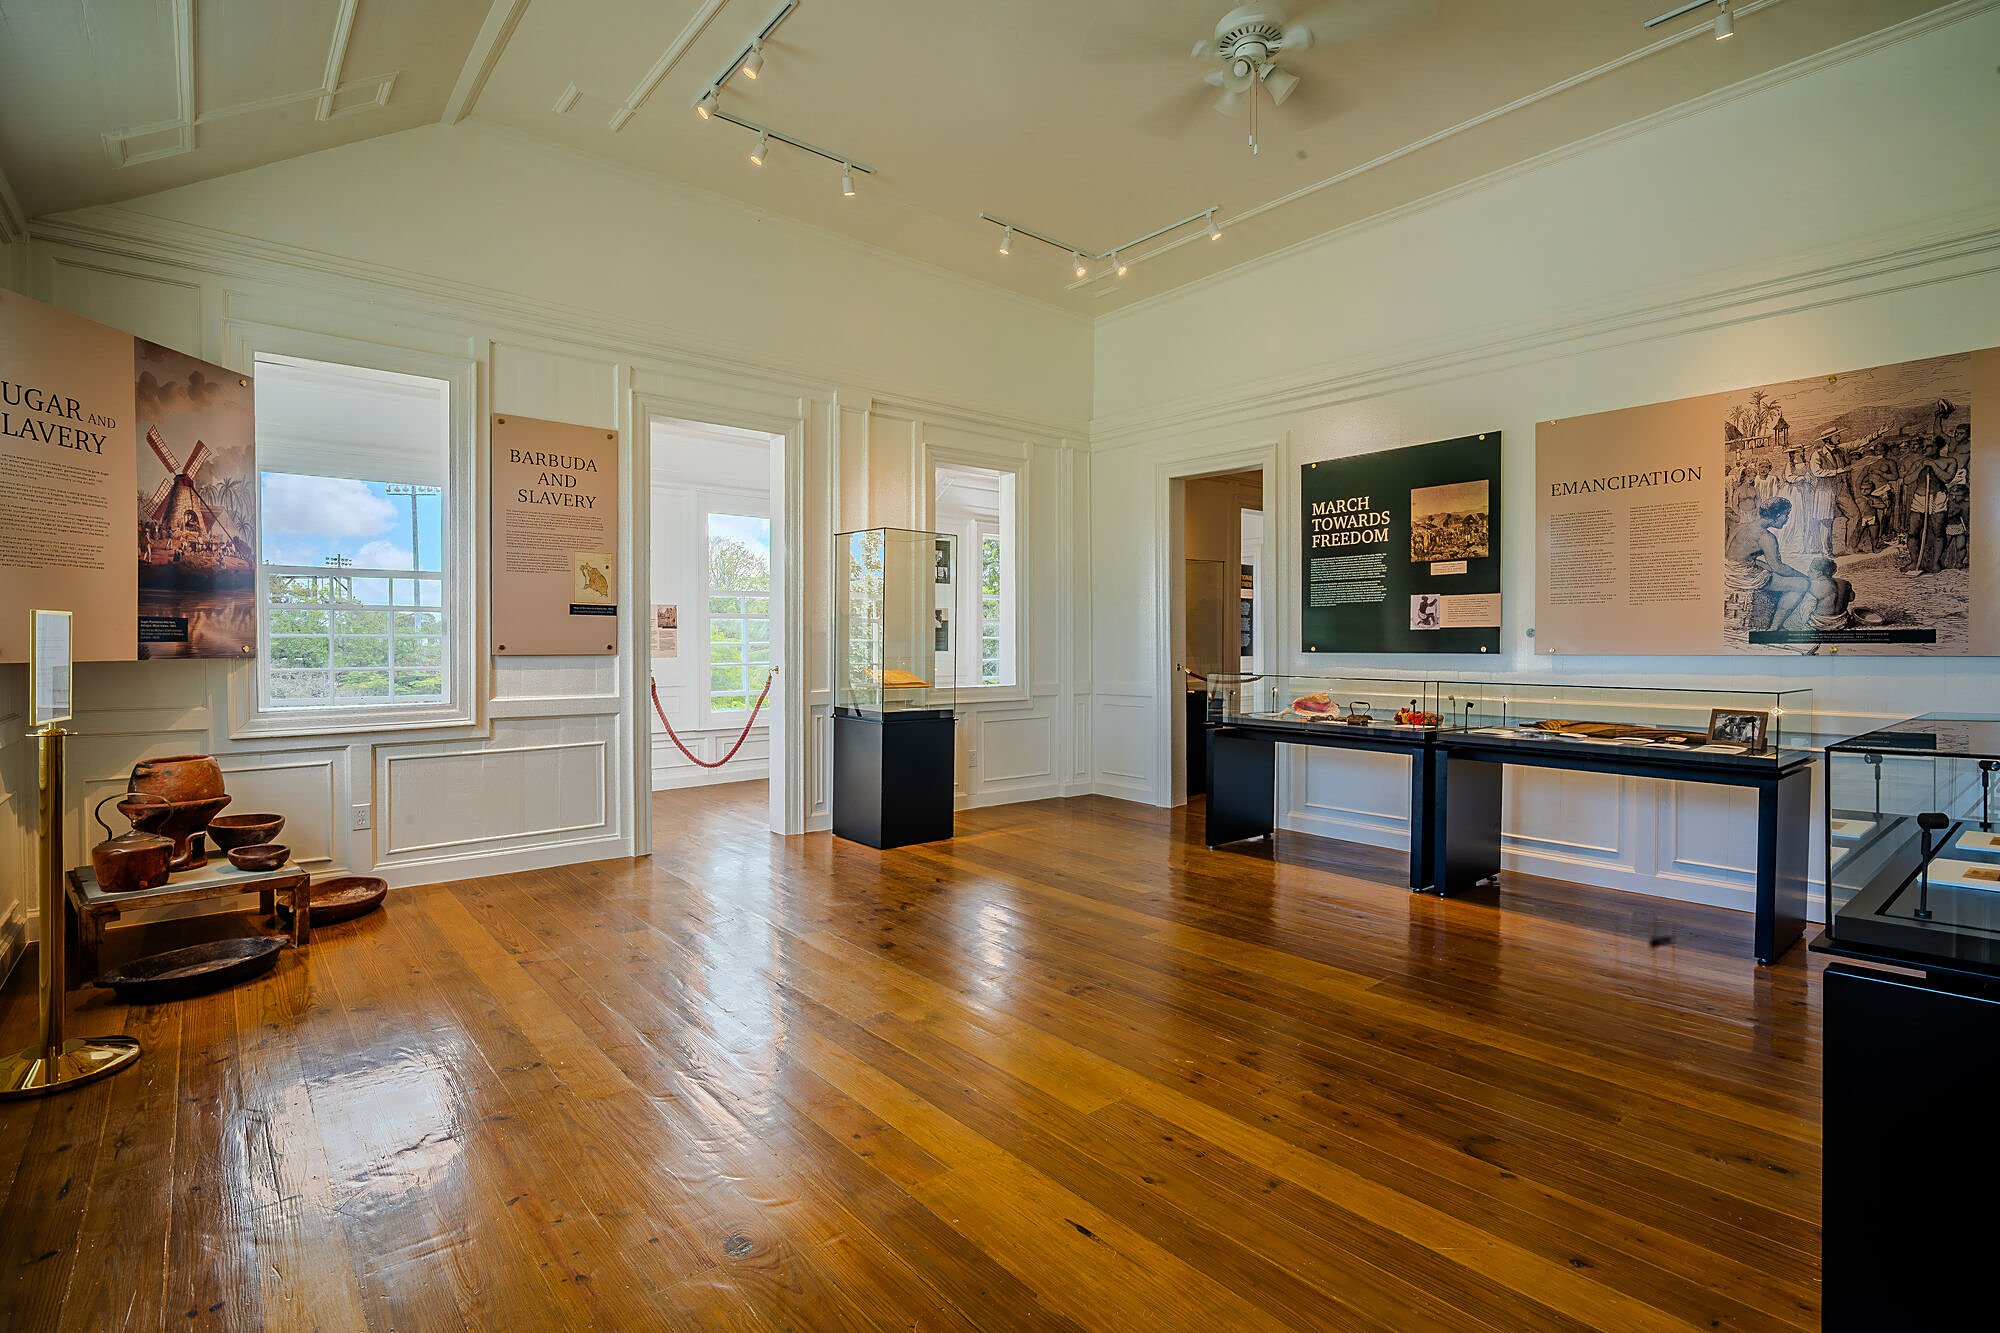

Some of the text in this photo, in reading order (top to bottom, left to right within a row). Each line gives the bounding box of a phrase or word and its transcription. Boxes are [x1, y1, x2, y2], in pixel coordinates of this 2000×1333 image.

[87, 413, 116, 429] AND
[510, 448, 598, 473] BARBUDA
[537, 471, 577, 488] AND
[1551, 466, 1702, 497] EMANCIPATION
[517, 488, 597, 509] SLAVERY
[1311, 496, 1370, 516] MARCH
[1311, 510, 1391, 532] TOWARDS
[1311, 527, 1389, 549] FREEDOM
